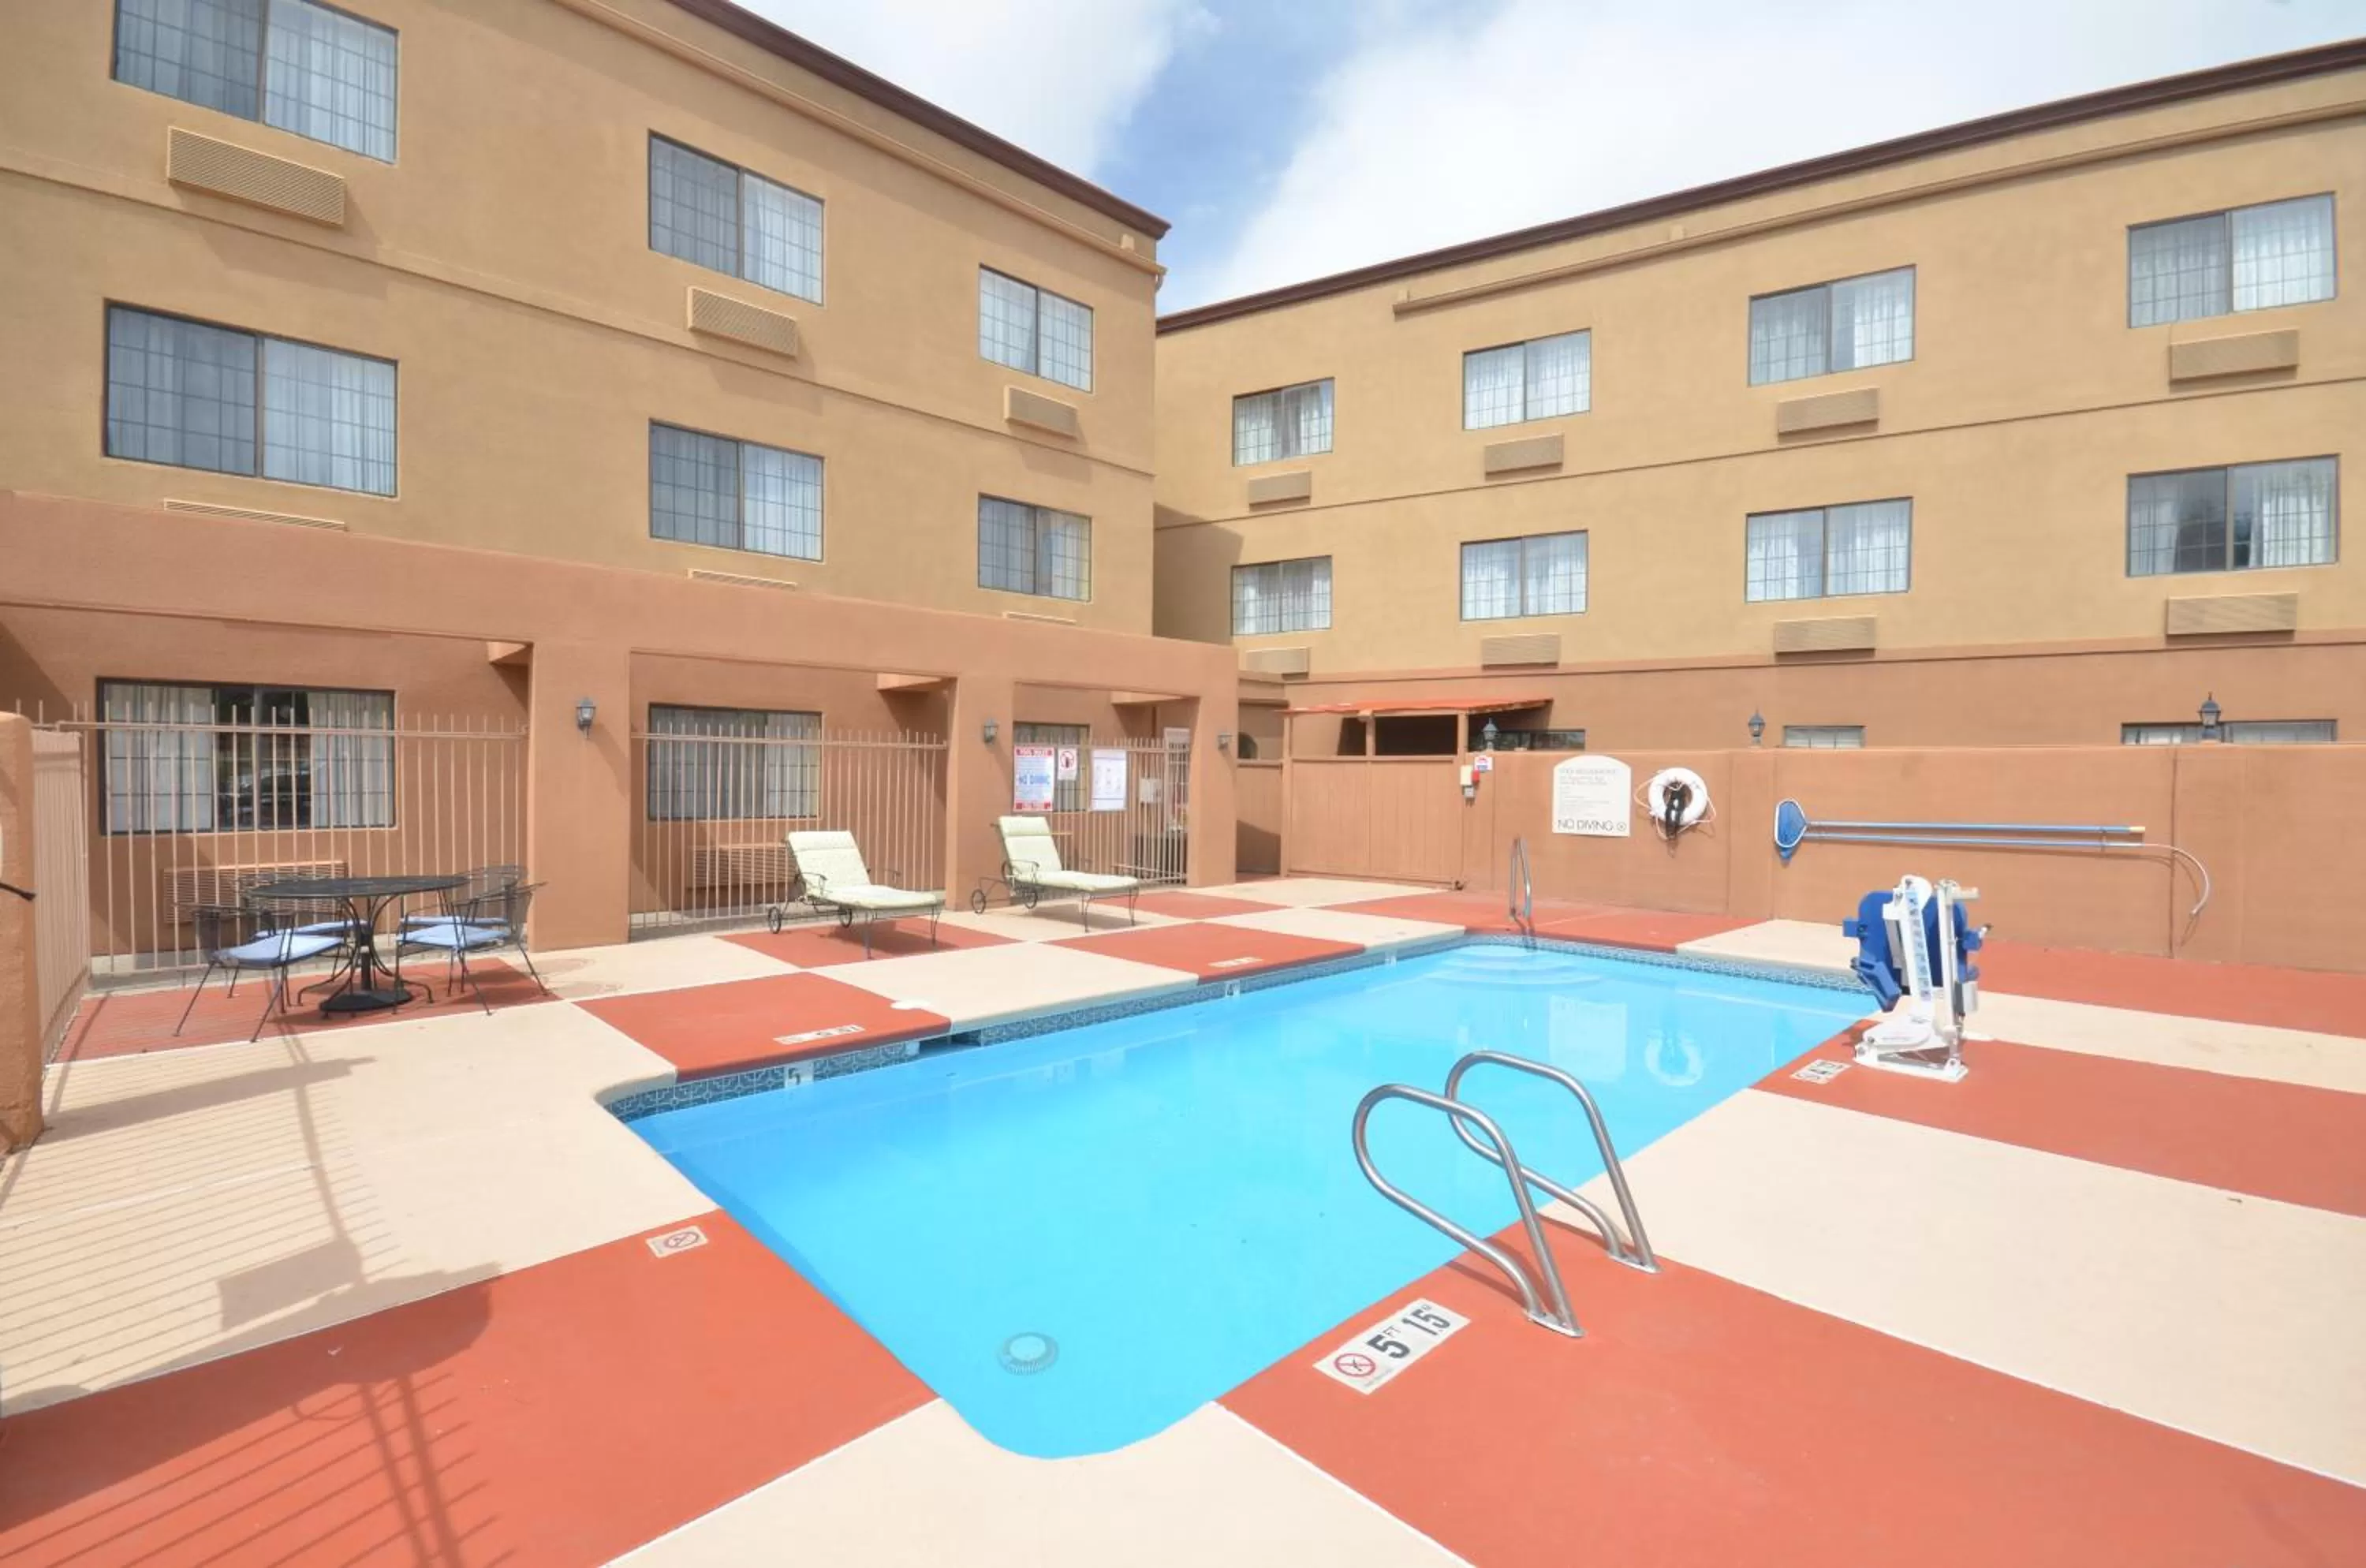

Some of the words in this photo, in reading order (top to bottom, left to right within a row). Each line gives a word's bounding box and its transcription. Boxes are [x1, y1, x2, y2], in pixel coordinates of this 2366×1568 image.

[1558, 819, 1575, 829] NO
[1577, 819, 1614, 831] DIVING
[1367, 1334, 1410, 1359] 5
